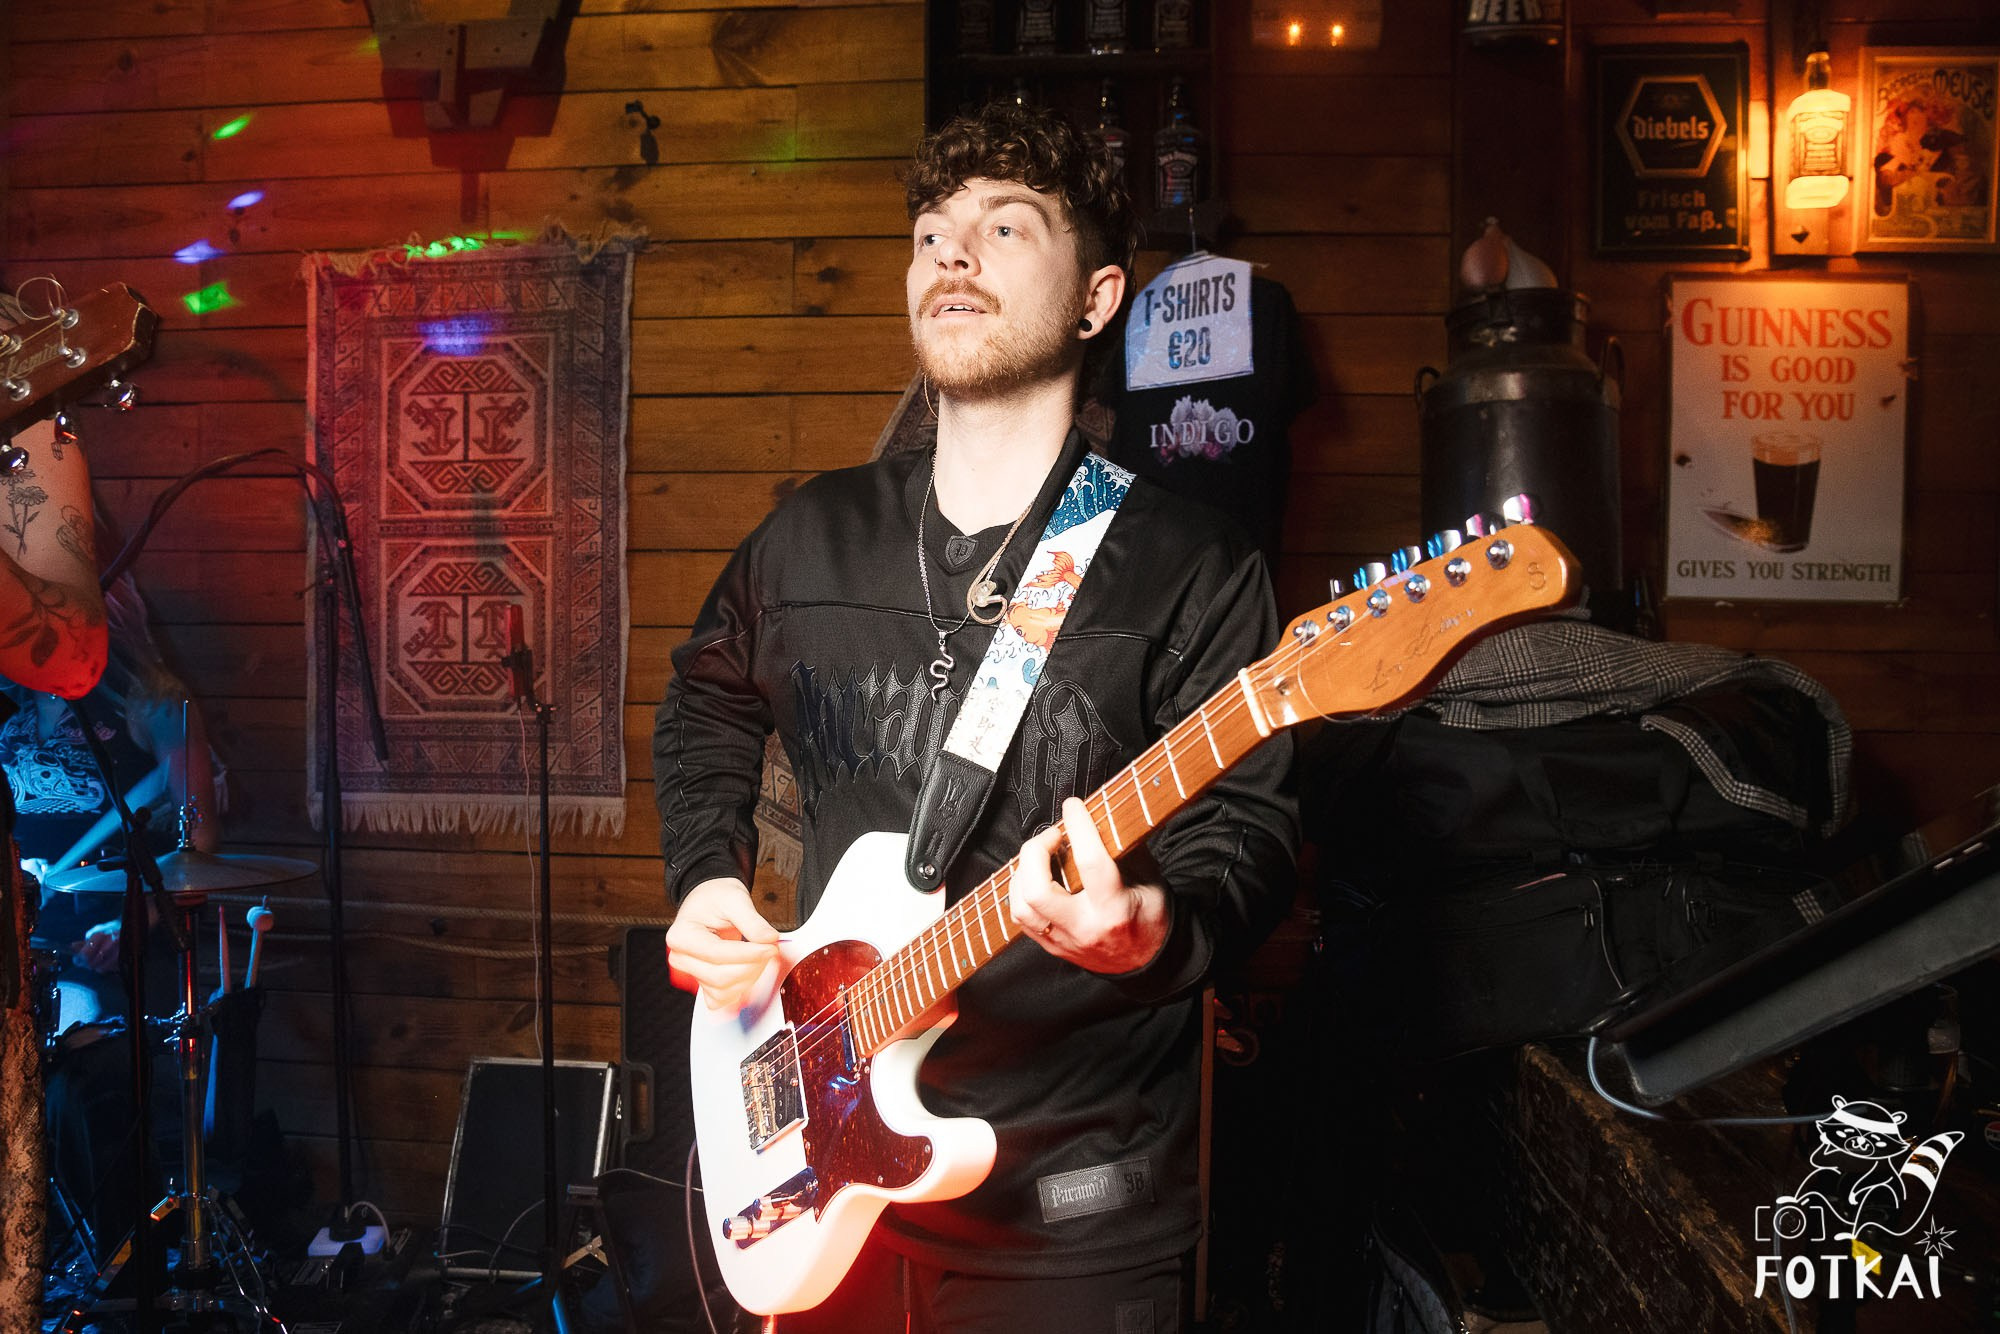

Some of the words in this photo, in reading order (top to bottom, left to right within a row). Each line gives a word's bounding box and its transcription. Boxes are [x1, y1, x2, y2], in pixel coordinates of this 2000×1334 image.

[1933, 69, 1994, 120] MEUSE
[1632, 115, 1709, 140] Diebels
[1638, 189, 1706, 208] Frisch
[1624, 213, 1671, 229] vom
[1144, 272, 1235, 326] T-SHIRTS
[1681, 297, 1893, 349] GUINNESS
[1167, 327, 1211, 369] €20
[1720, 355, 1749, 382] IS
[1771, 356, 1856, 384] GOOD
[1722, 391, 1783, 420] FOR
[1791, 392, 1856, 421] YOU
[1150, 419, 1254, 448] INDIGO
[1676, 559, 1735, 579] GIVES
[1747, 561, 1783, 580] YOU
[1791, 562, 1892, 583] STRENGTH
